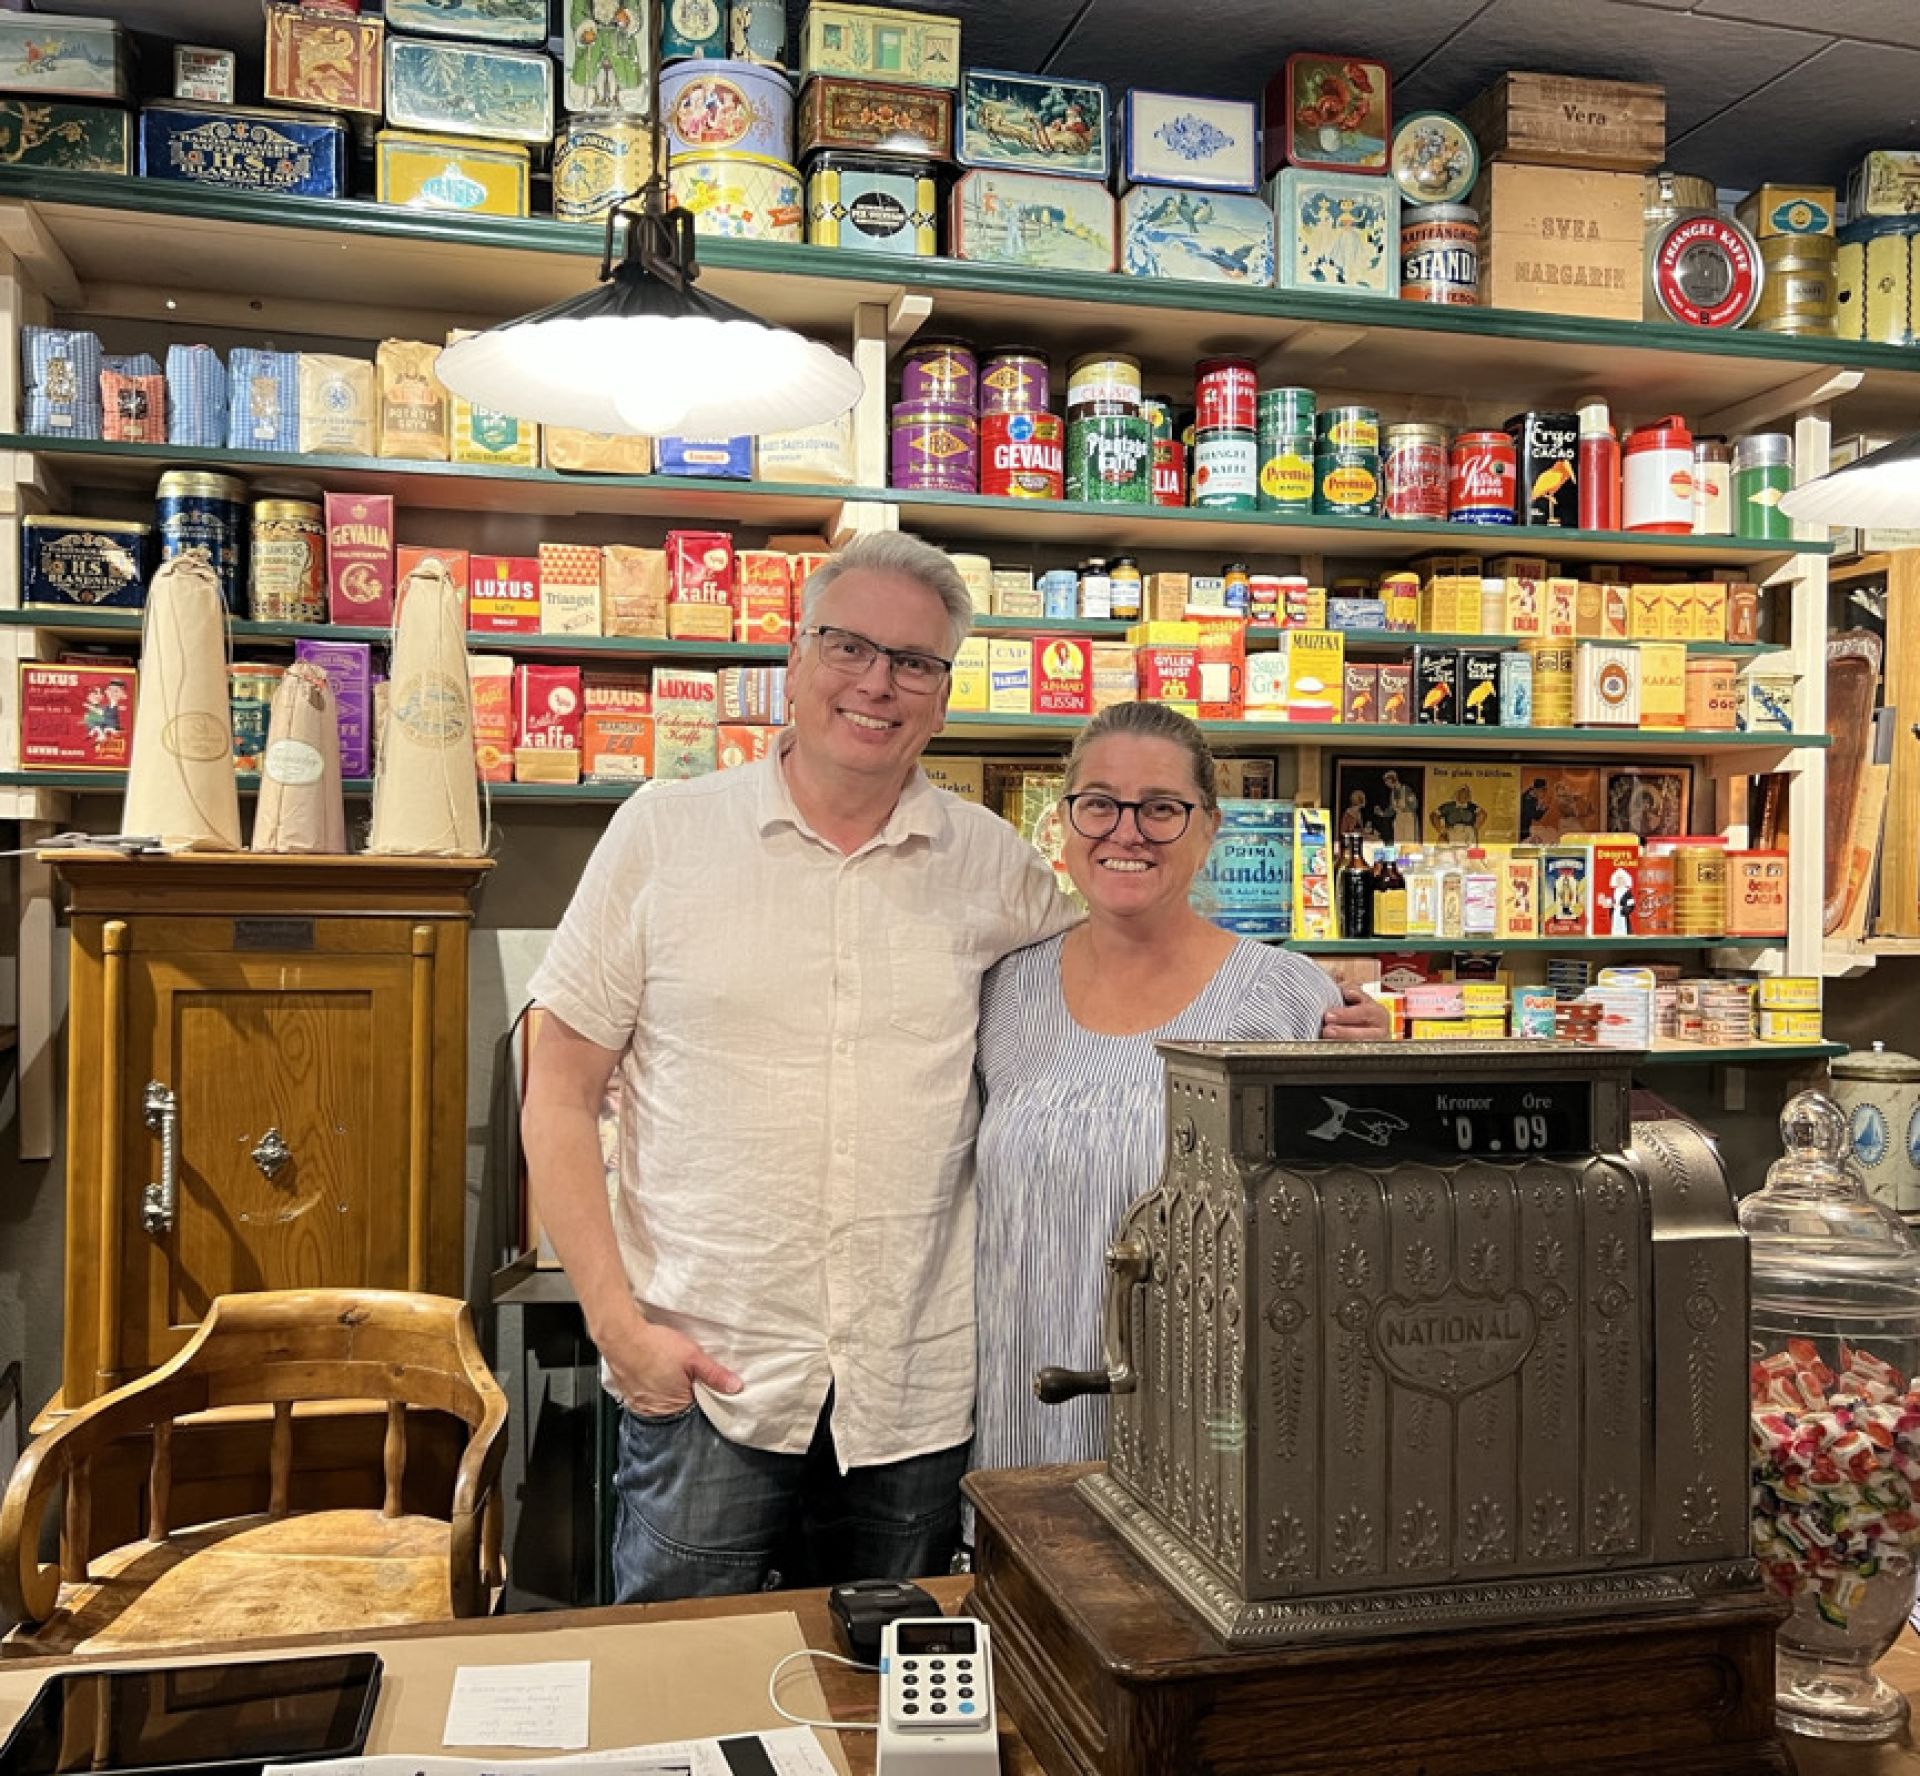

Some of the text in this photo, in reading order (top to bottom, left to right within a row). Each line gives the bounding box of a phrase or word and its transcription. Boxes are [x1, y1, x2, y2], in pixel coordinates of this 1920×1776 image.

[1563, 103, 1607, 126] Vera
[1541, 216, 1600, 241] SVEA
[1664, 223, 1750, 272] TRIANGEL KAFFE
[1515, 261, 1626, 289] MARGARIN
[1532, 447, 1575, 459] CACAO
[331, 524, 391, 552] GEVALIA
[473, 579, 535, 599] LUXUS
[678, 580, 728, 605] kaffe
[546, 591, 597, 608] Triangel
[1293, 633, 1340, 651] MAIZENA
[1153, 655, 1196, 668] GYLLEN
[29, 672, 80, 688] LUXUS
[1158, 666, 1192, 679] MUST
[1642, 674, 1684, 687] KAKAO
[656, 679, 716, 703] LUXUS
[1039, 696, 1085, 711] RUSSIN
[521, 725, 574, 750] kaffe
[1223, 844, 1277, 859] PRIMA
[1436, 1094, 1493, 1112] Kronor
[1386, 1311, 1522, 1346] NATIONAL
